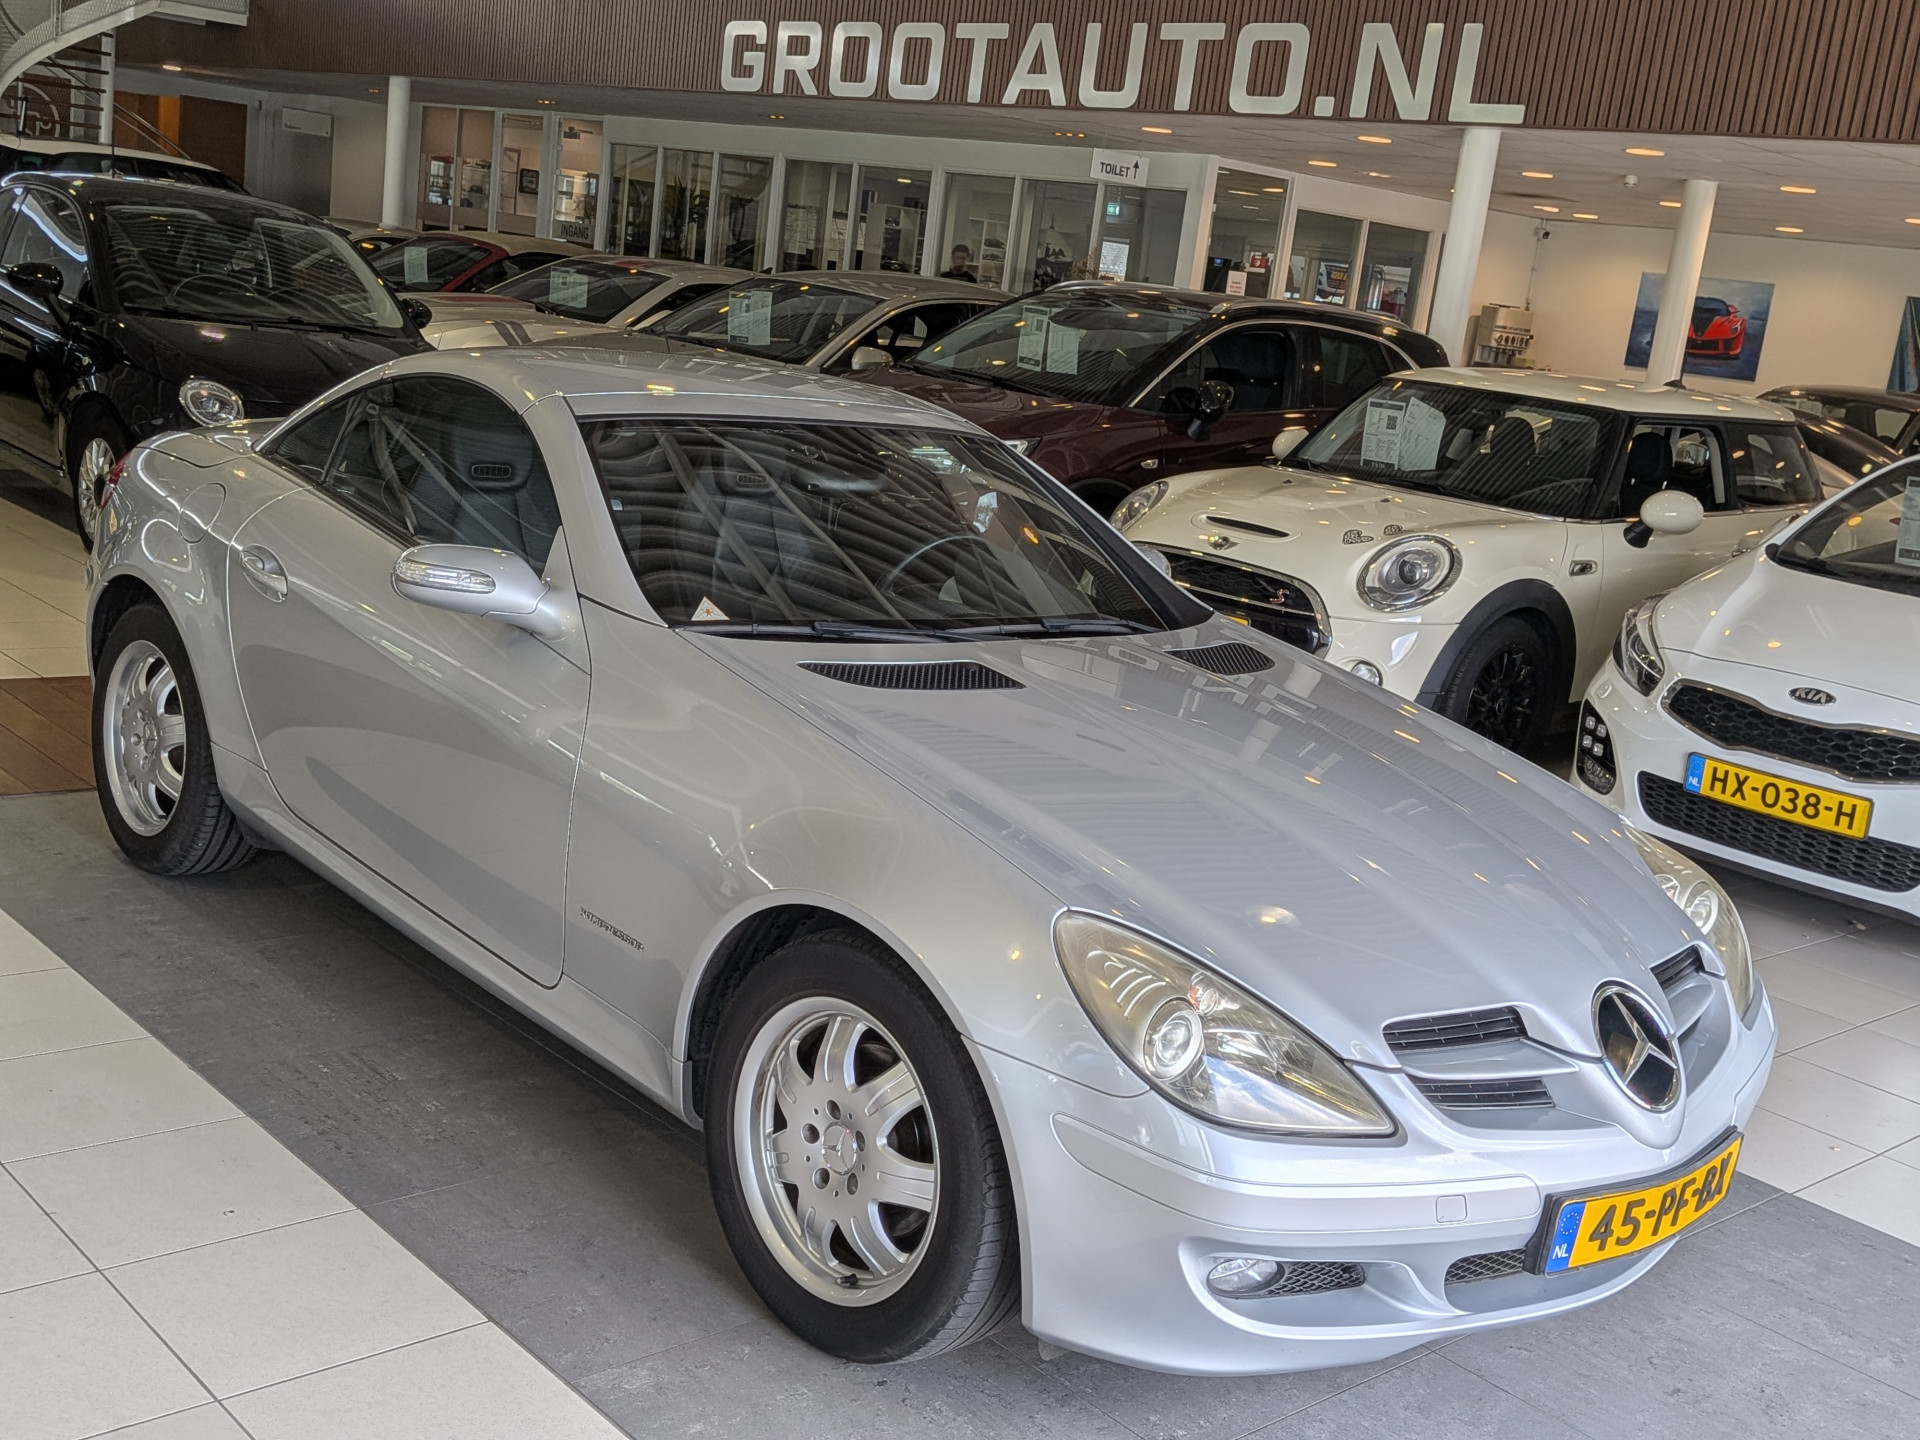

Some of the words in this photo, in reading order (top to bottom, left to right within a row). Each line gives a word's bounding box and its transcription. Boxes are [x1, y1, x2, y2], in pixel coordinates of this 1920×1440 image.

[720, 19, 1526, 124] GROOTAUTO.NL
[1100, 161, 1131, 178] TOILET
[561, 223, 589, 240] INGANG
[1794, 688, 1827, 703] KIA
[1688, 775, 1700, 788] NL
[1709, 766, 1858, 830] HX-038-H
[1552, 1243, 1569, 1260] NL
[1588, 1151, 1734, 1252] 45-PF-BX
